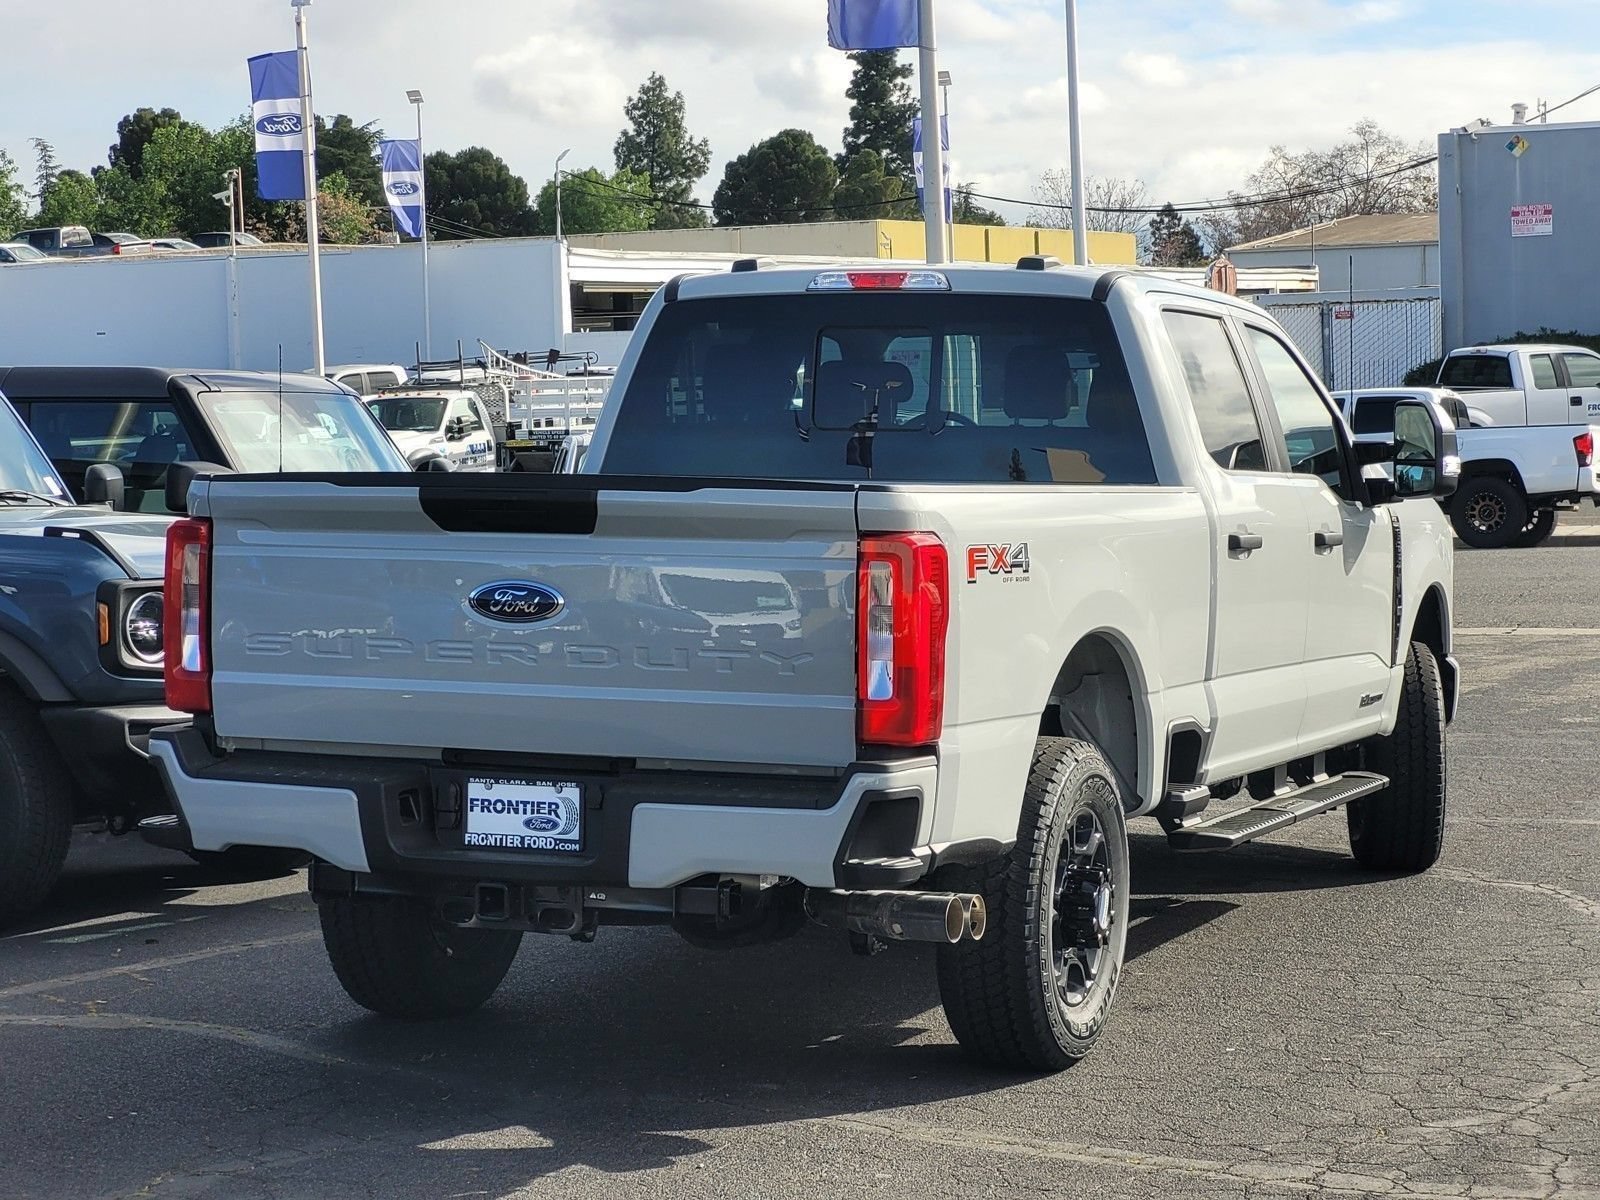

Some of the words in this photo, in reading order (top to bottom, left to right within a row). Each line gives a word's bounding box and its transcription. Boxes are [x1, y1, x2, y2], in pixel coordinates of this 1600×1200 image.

[966, 543, 1030, 584] FX4
[489, 588, 540, 613] Ford
[245, 632, 538, 667] SUPER
[563, 643, 814, 676] DUTY
[498, 778, 527, 786] CLARA
[469, 797, 562, 821] FRONTIER
[530, 818, 554, 830] Ford
[464, 833, 522, 848] FRONTIER
